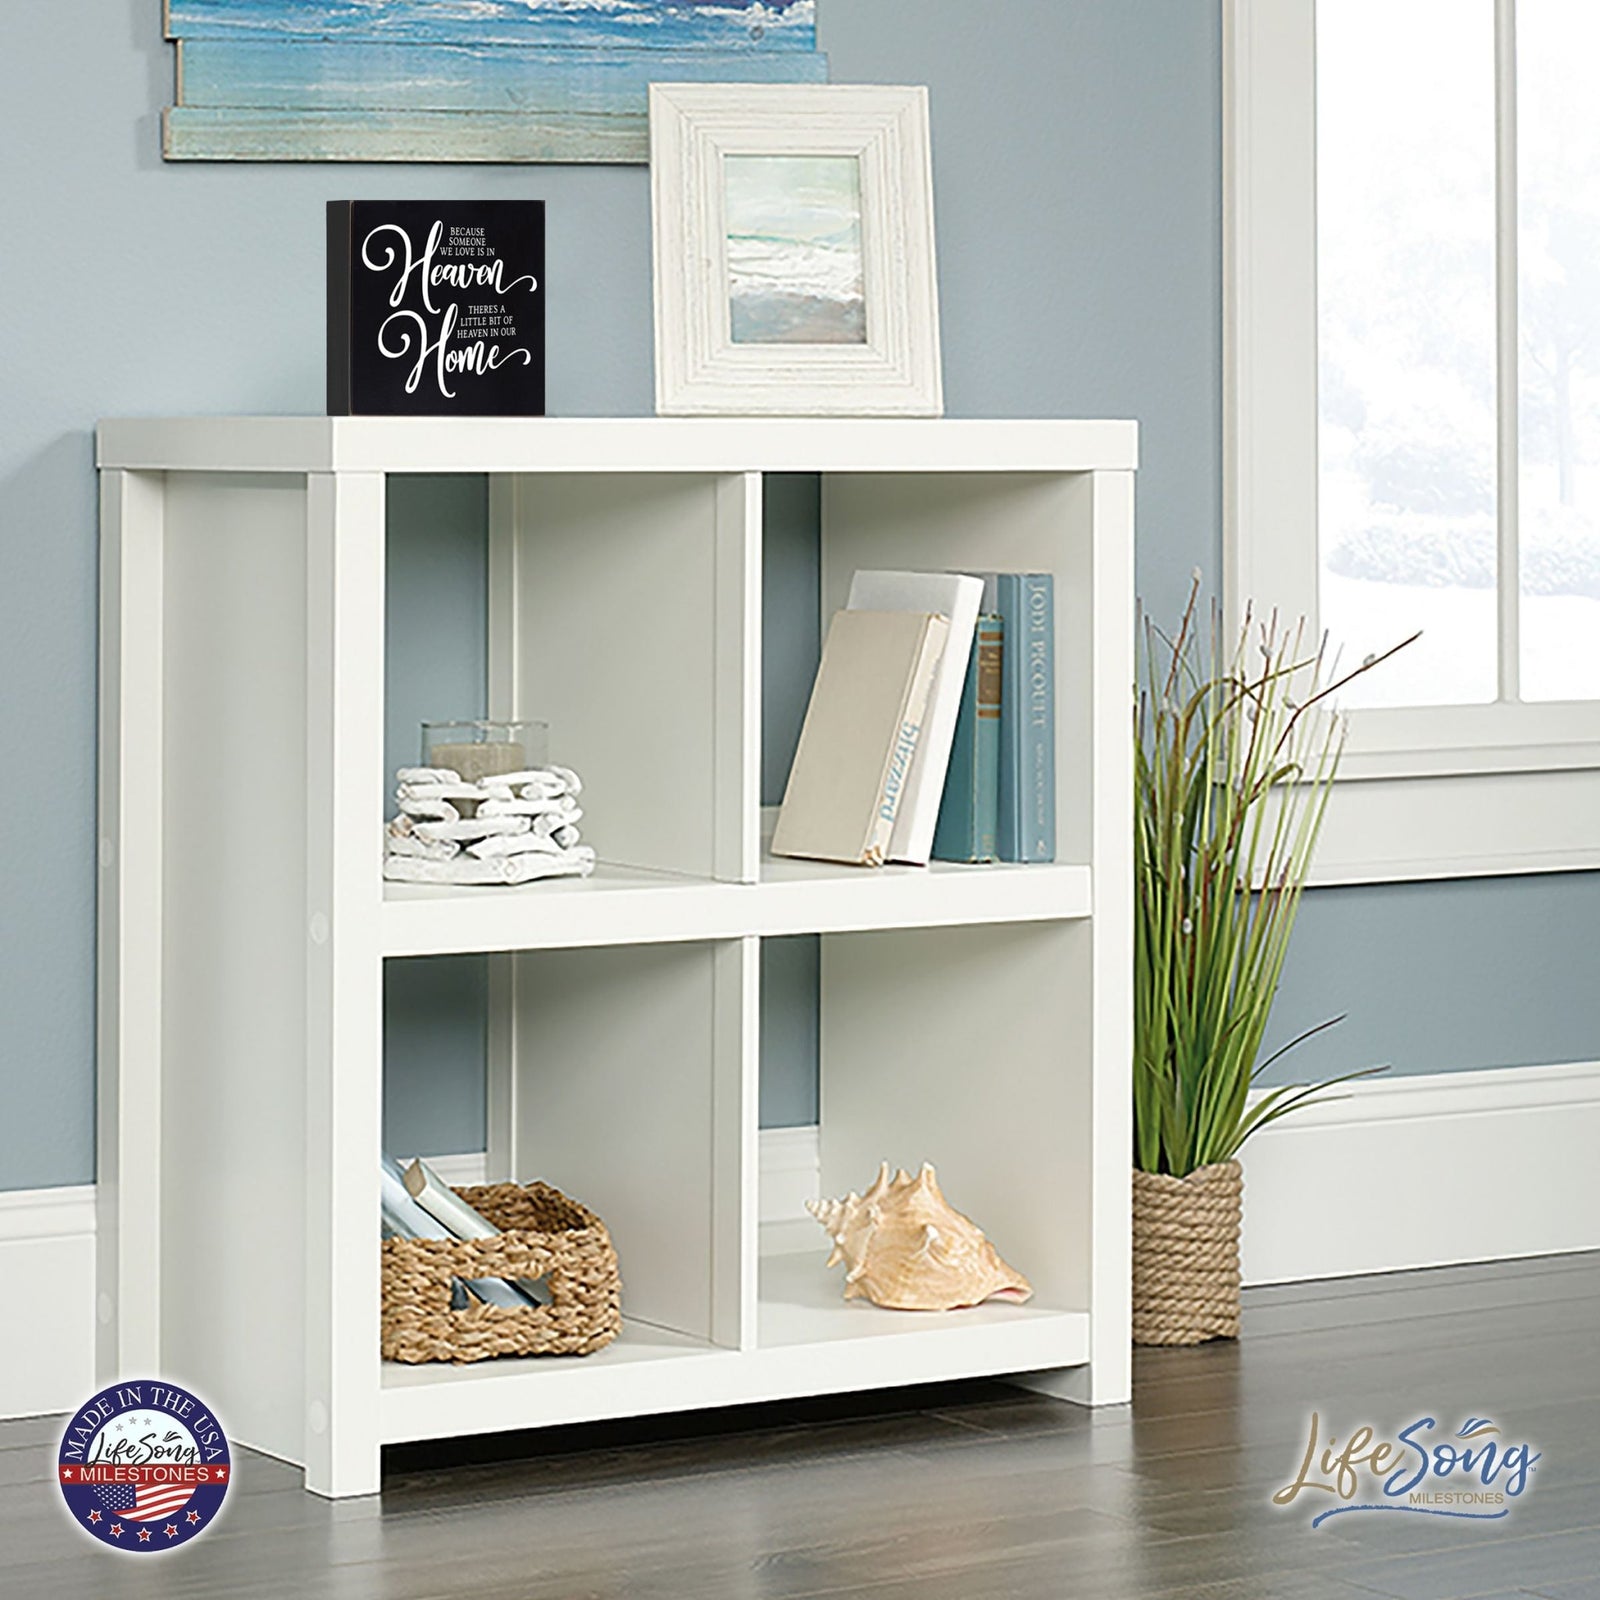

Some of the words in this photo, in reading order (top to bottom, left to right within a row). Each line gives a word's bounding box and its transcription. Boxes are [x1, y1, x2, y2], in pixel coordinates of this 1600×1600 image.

[450, 227, 485, 237] BECAUSE
[449, 237, 486, 246] SOMEONE
[440, 247, 453, 256] WE
[455, 247, 476, 256] LOVE
[477, 247, 485, 256] IS
[486, 247, 495, 256] IN
[361, 220, 537, 314] Heaven
[468, 305, 498, 314] THERES
[499, 305, 506, 314] A
[460, 317, 487, 327] LITTLE
[489, 316, 501, 326] BIT
[503, 316, 514, 325] OF
[457, 329, 488, 339] HEAVEN
[490, 328, 499, 337] IN
[500, 327, 516, 337] OUR
[378, 303, 531, 398] Home
[1028, 584, 1047, 632] JODI
